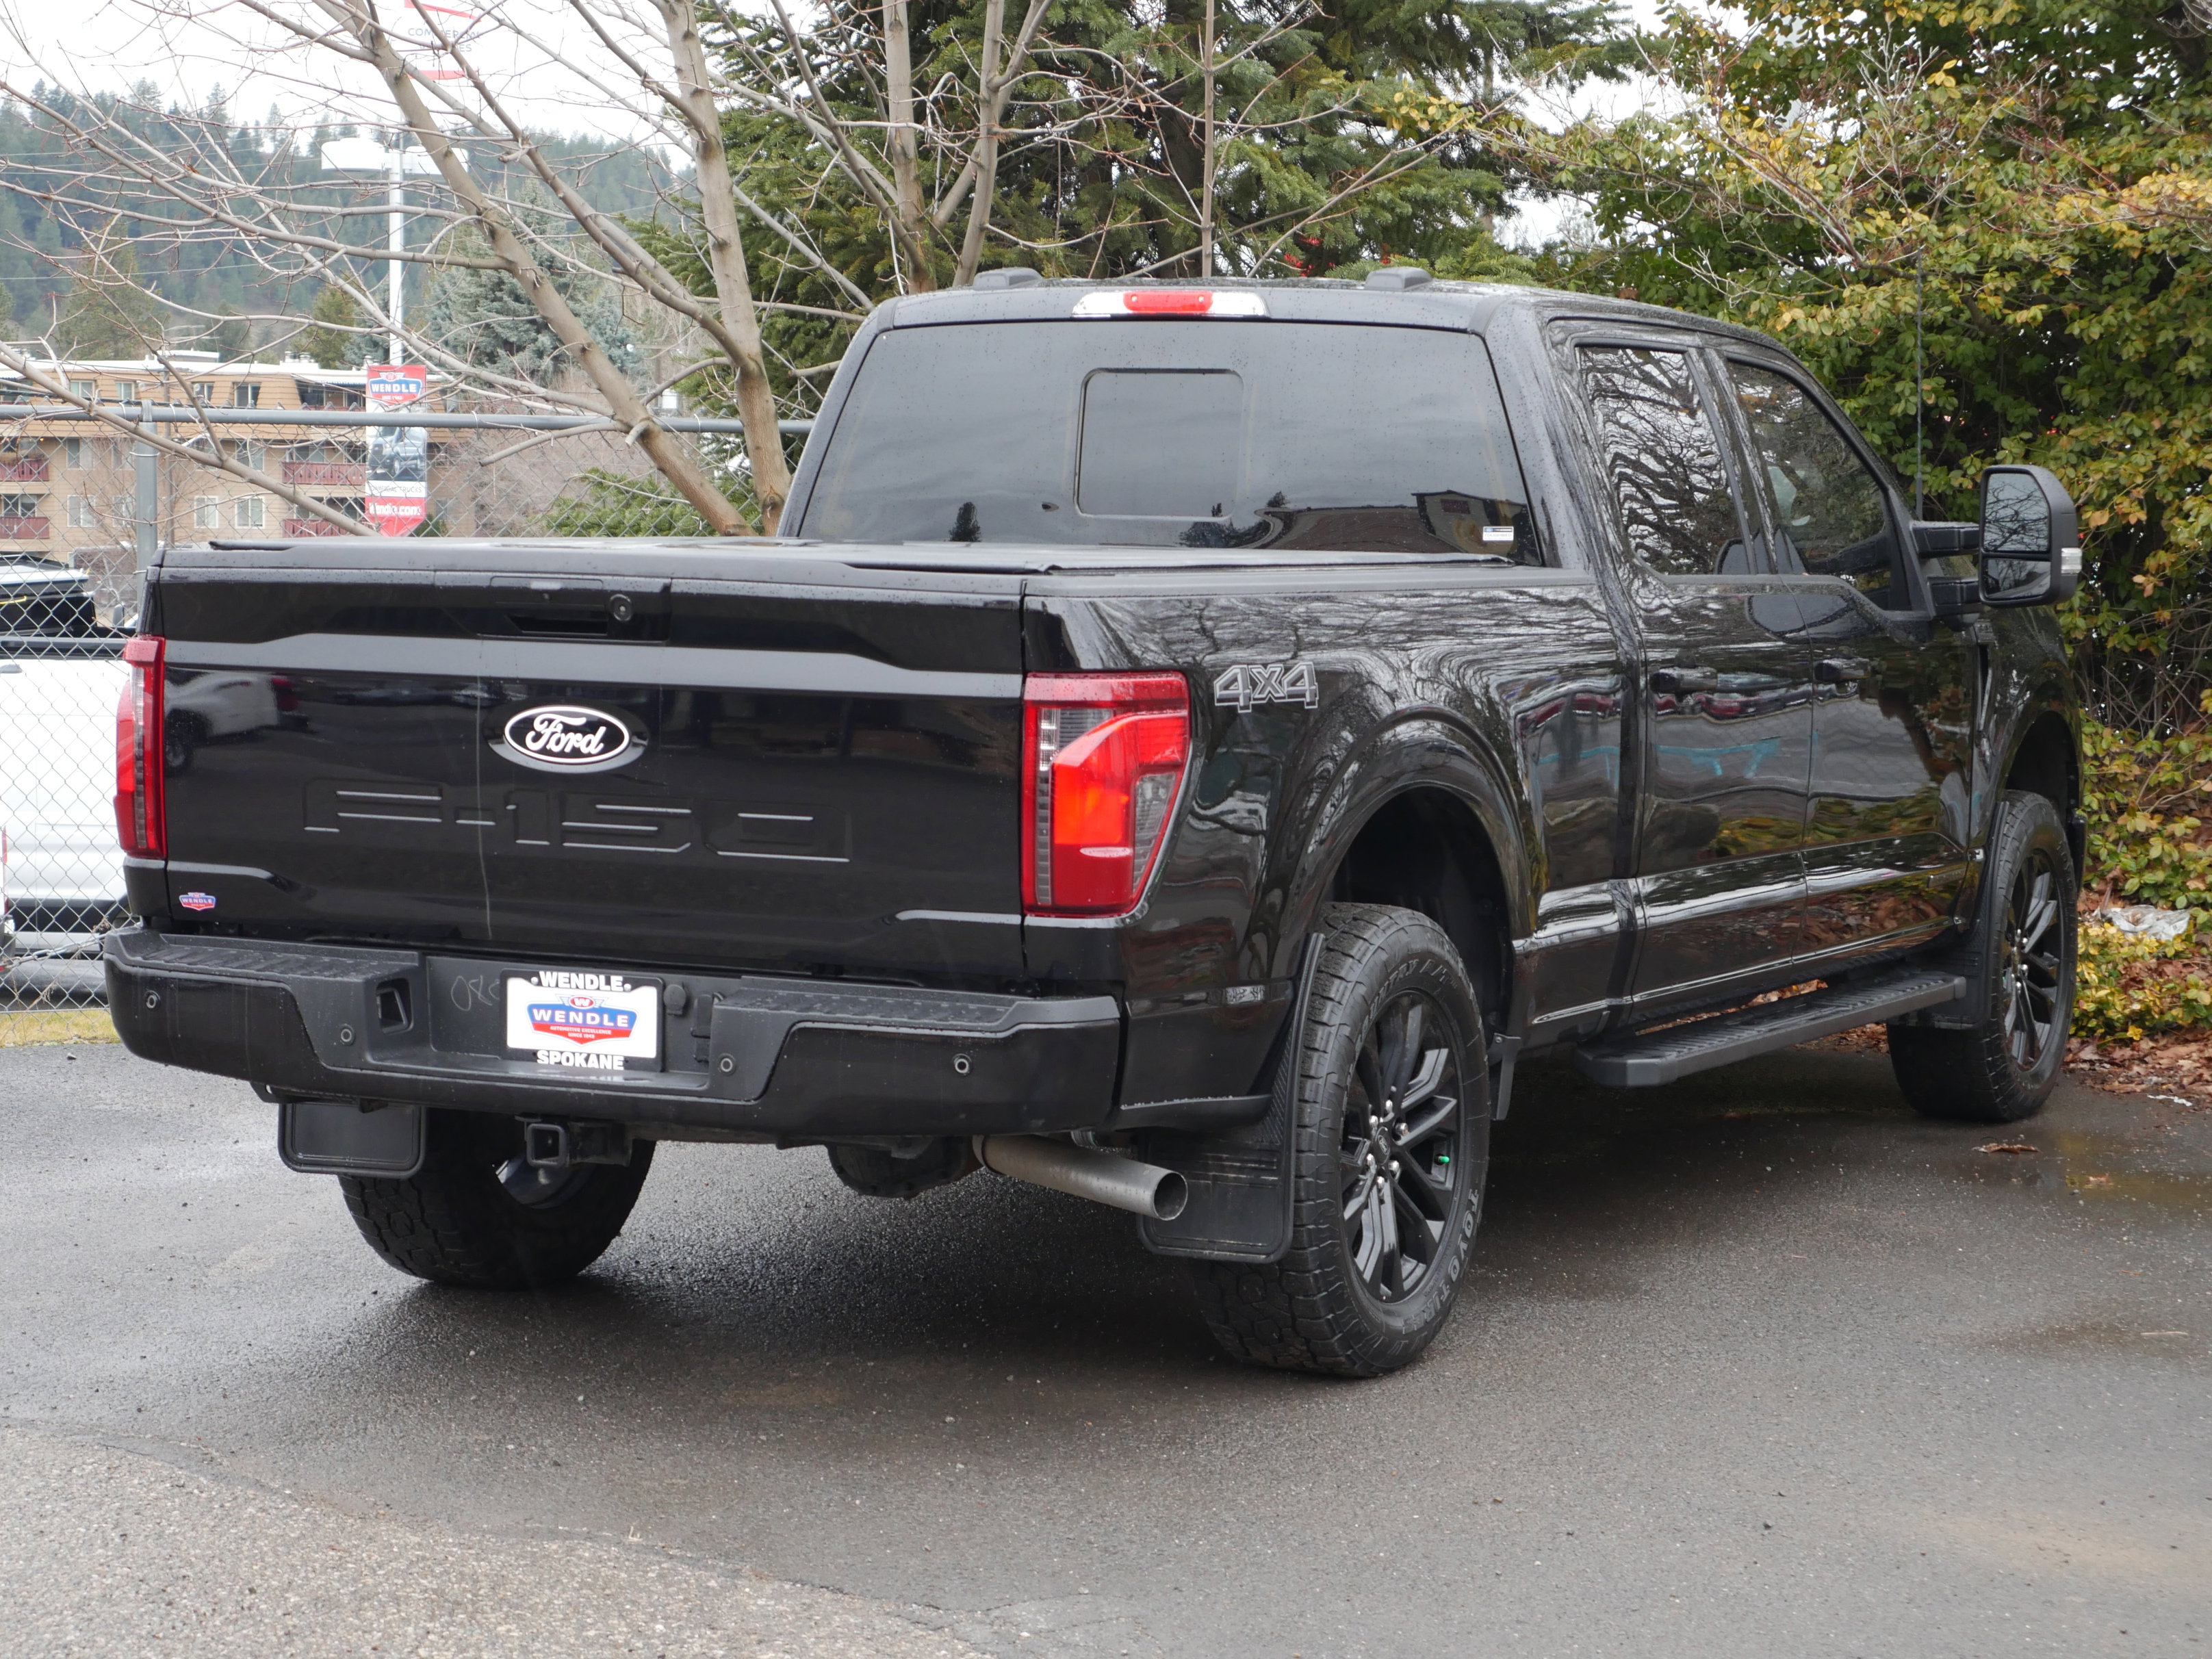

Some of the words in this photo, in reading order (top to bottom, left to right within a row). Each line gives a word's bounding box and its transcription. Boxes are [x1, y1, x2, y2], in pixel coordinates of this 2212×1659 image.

[371, 383, 417, 393] WENDLE
[525, 712, 607, 754] Ford
[539, 970, 624, 992] WENDLE
[574, 997, 591, 1007] W
[532, 1008, 629, 1027] WENDLE
[537, 1049, 625, 1070] SPOKANE
[1448, 1188, 1479, 1283] TOYO
